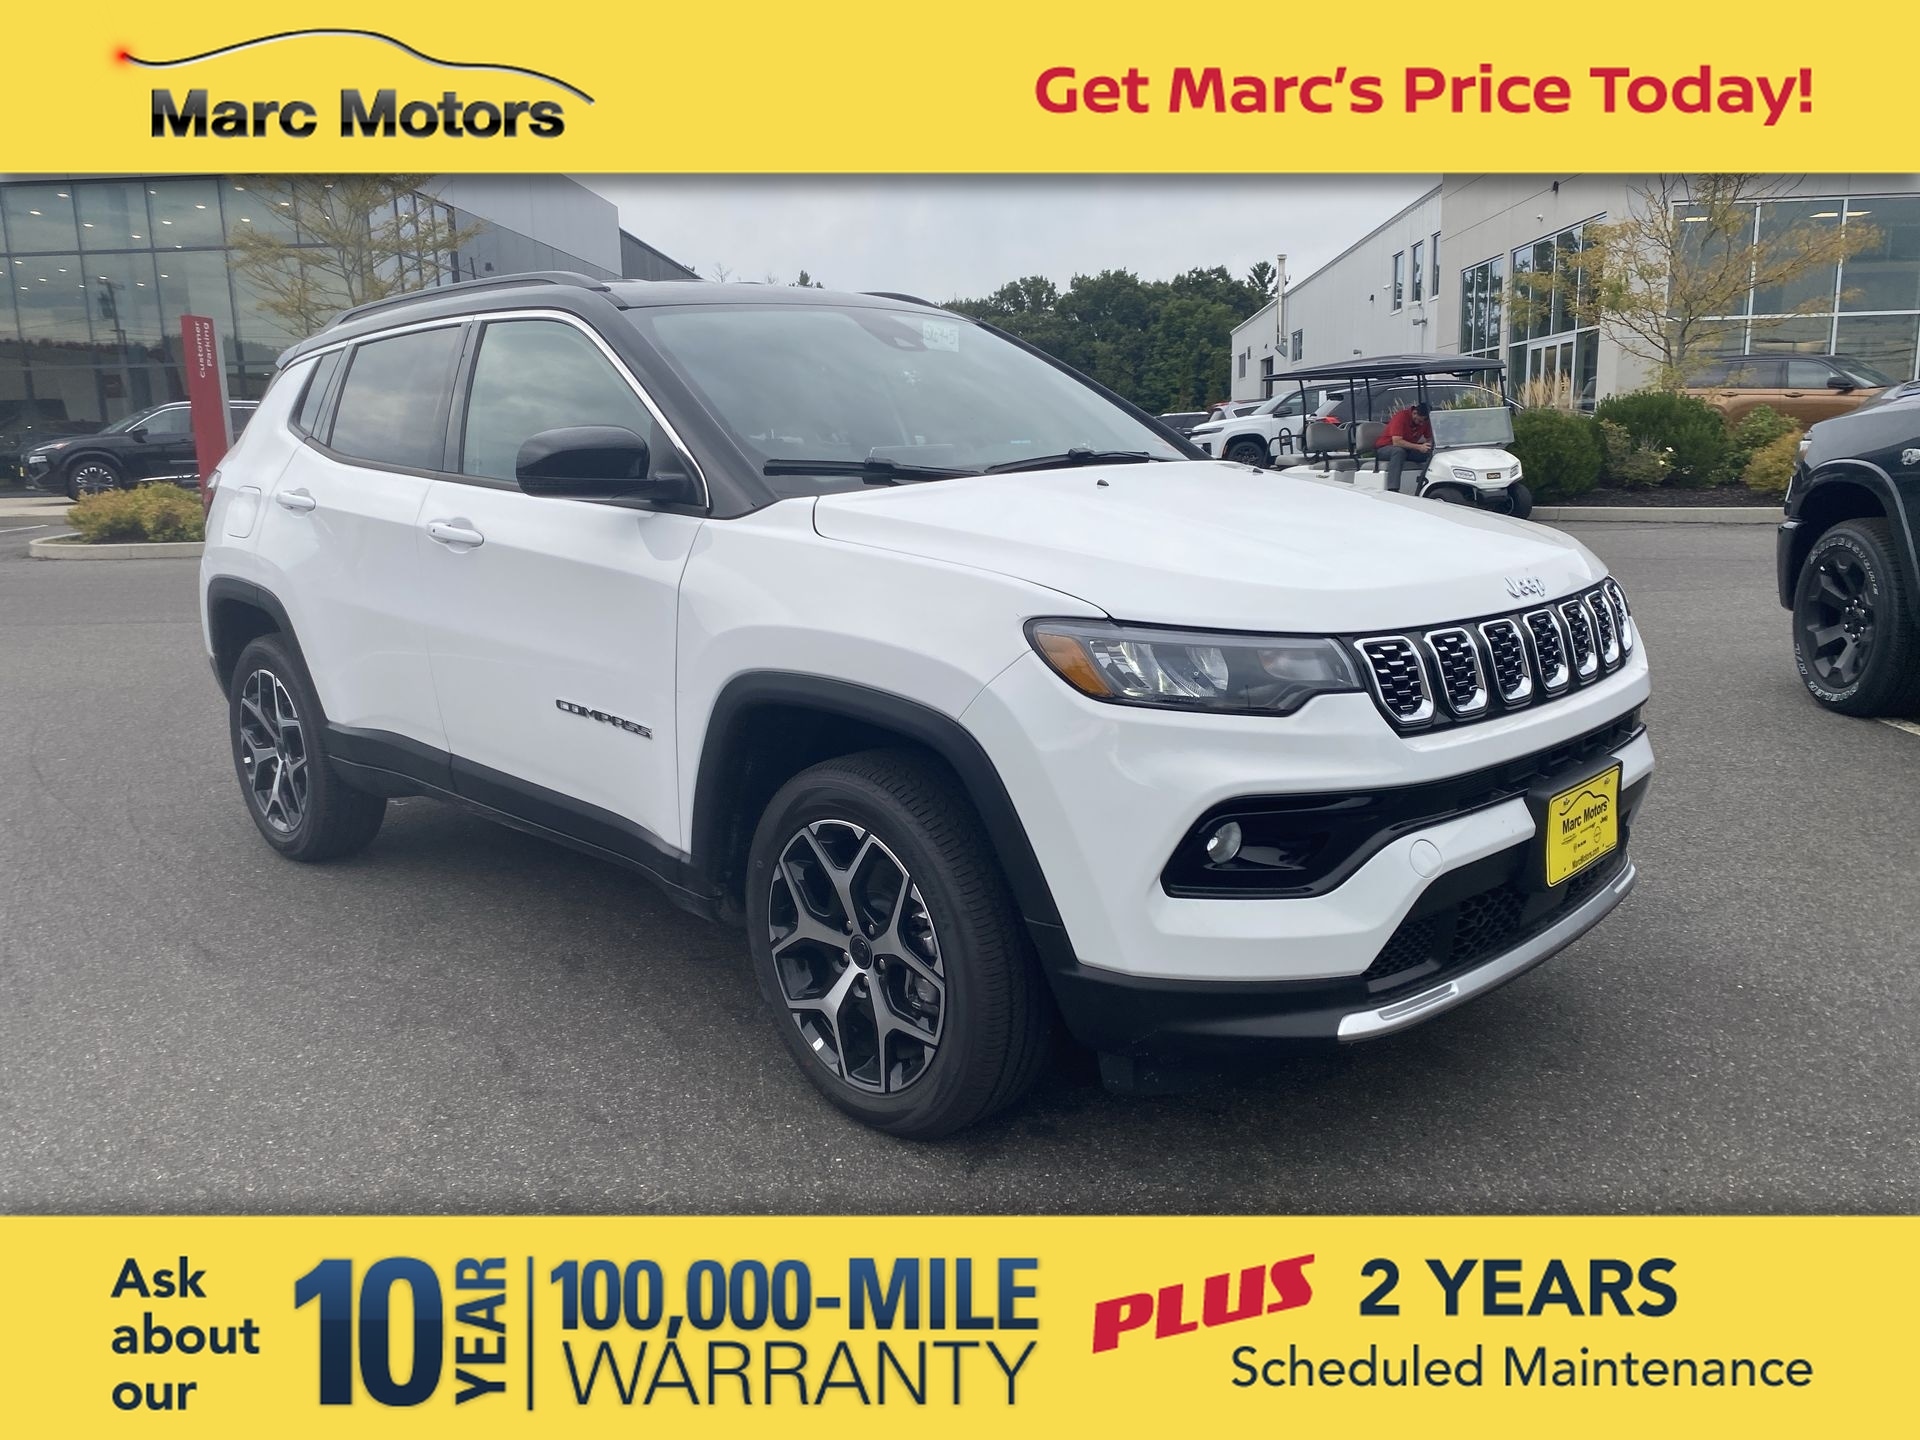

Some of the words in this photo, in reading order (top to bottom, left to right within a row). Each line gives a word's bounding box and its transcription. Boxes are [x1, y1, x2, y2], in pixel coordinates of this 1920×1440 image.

[195, 321, 206, 378] Customer
[203, 322, 213, 367] Parking
[1505, 576, 1545, 599] Jeep
[556, 698, 653, 740] COMPASS
[1562, 815, 1582, 835] Marc
[1583, 800, 1608, 823] Motors
